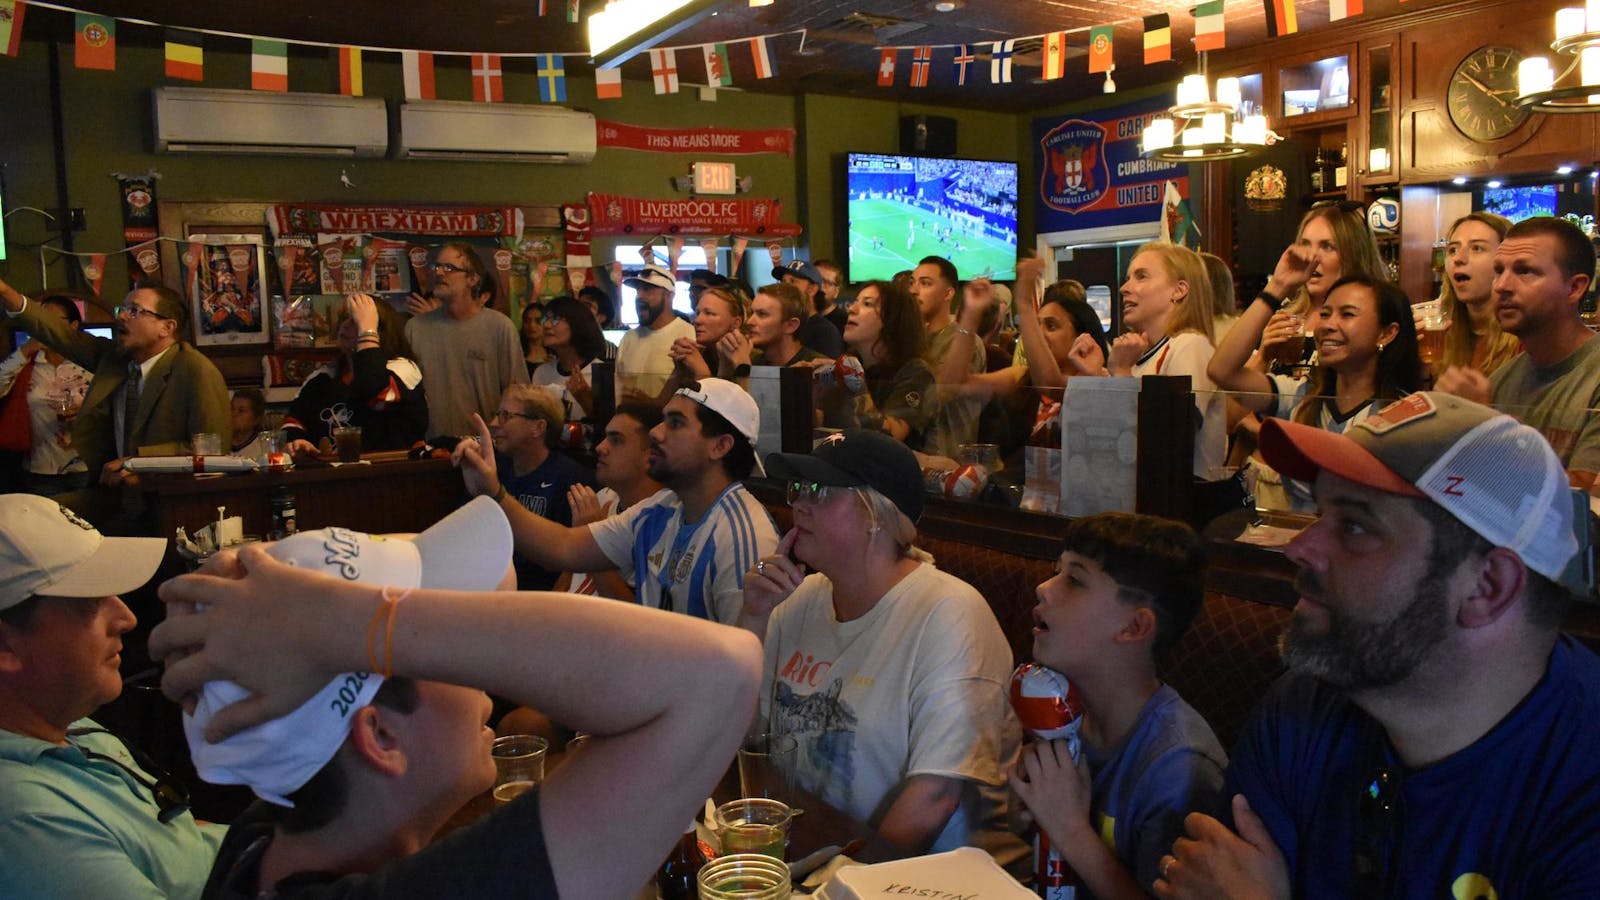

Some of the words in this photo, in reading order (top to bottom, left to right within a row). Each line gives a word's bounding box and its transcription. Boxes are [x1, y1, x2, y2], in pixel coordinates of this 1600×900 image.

[647, 134, 671, 147] THIS
[673, 134, 709, 148] MEANS
[711, 134, 741, 148] MORE
[701, 164, 732, 191] EXIT
[1117, 183, 1159, 207] UNITED
[640, 201, 720, 218] LIVERPOOL
[721, 202, 738, 217] FC
[327, 212, 474, 231] WREXHAM
